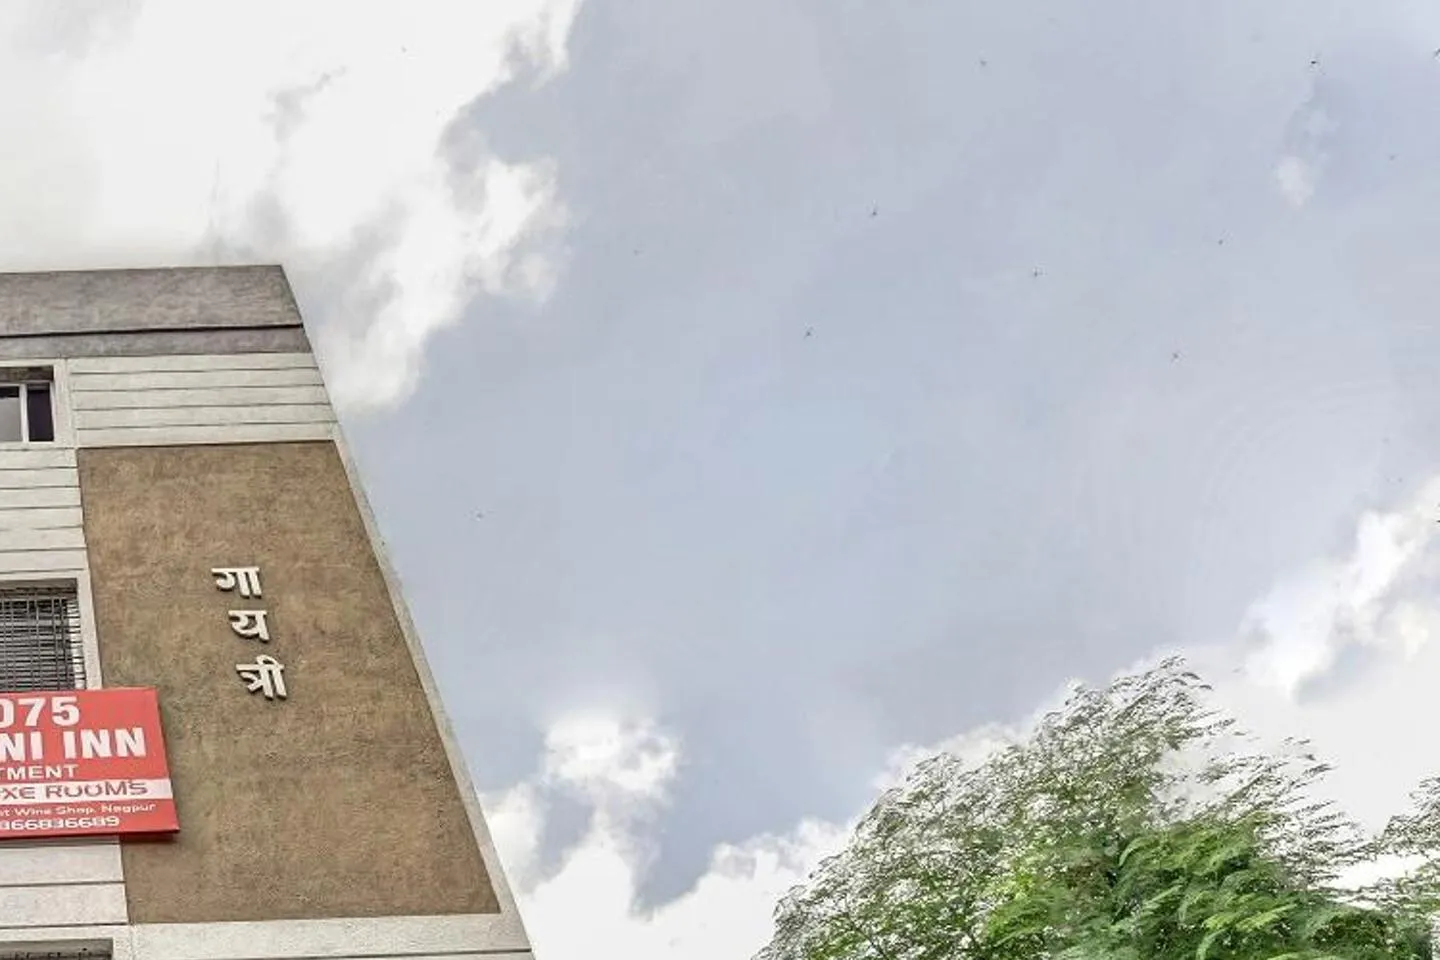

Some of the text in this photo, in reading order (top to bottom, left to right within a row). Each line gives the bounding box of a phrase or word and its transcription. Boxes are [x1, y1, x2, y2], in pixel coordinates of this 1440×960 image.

[63, 727, 147, 760] INN
[44, 781, 150, 798] ROOMS
[13, 806, 52, 817] Wine
[101, 802, 158, 815] Nagpur
